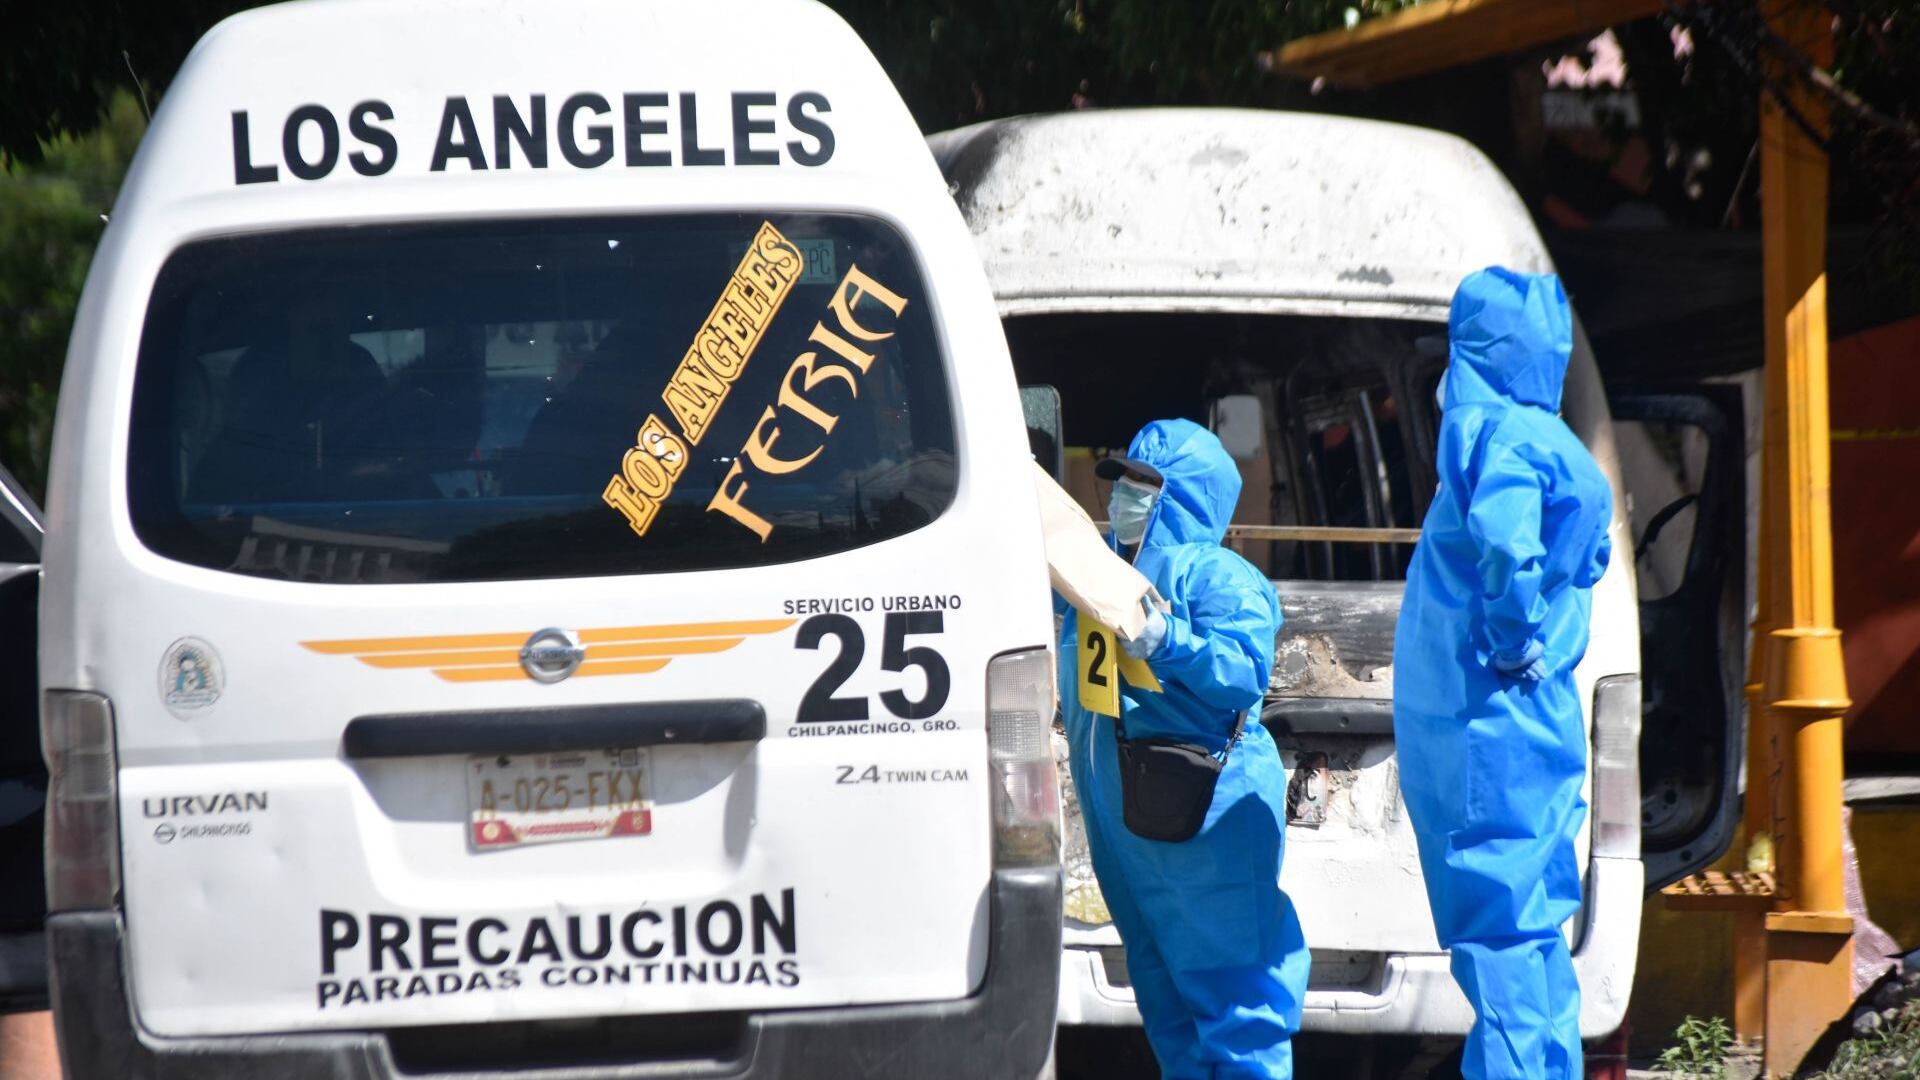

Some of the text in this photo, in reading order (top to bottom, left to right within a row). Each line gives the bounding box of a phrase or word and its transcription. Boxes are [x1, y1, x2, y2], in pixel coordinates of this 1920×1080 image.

[231, 91, 836, 185] LOS ANGELES
[602, 220, 803, 537] LOS ANGELES
[783, 594, 962, 615] SERVICIO URBANO
[794, 610, 951, 724] 25
[1087, 631, 1107, 688] 2
[787, 719, 961, 738] CHILPANCINGO, GRO.
[479, 769, 646, 821] A-025-FKX
[835, 764, 969, 785] 2.4 TWIN CAM
[142, 791, 268, 819] URVAN
[320, 887, 796, 975] PRECAUCION
[317, 960, 801, 1009] PARADAS CONTINUAS
